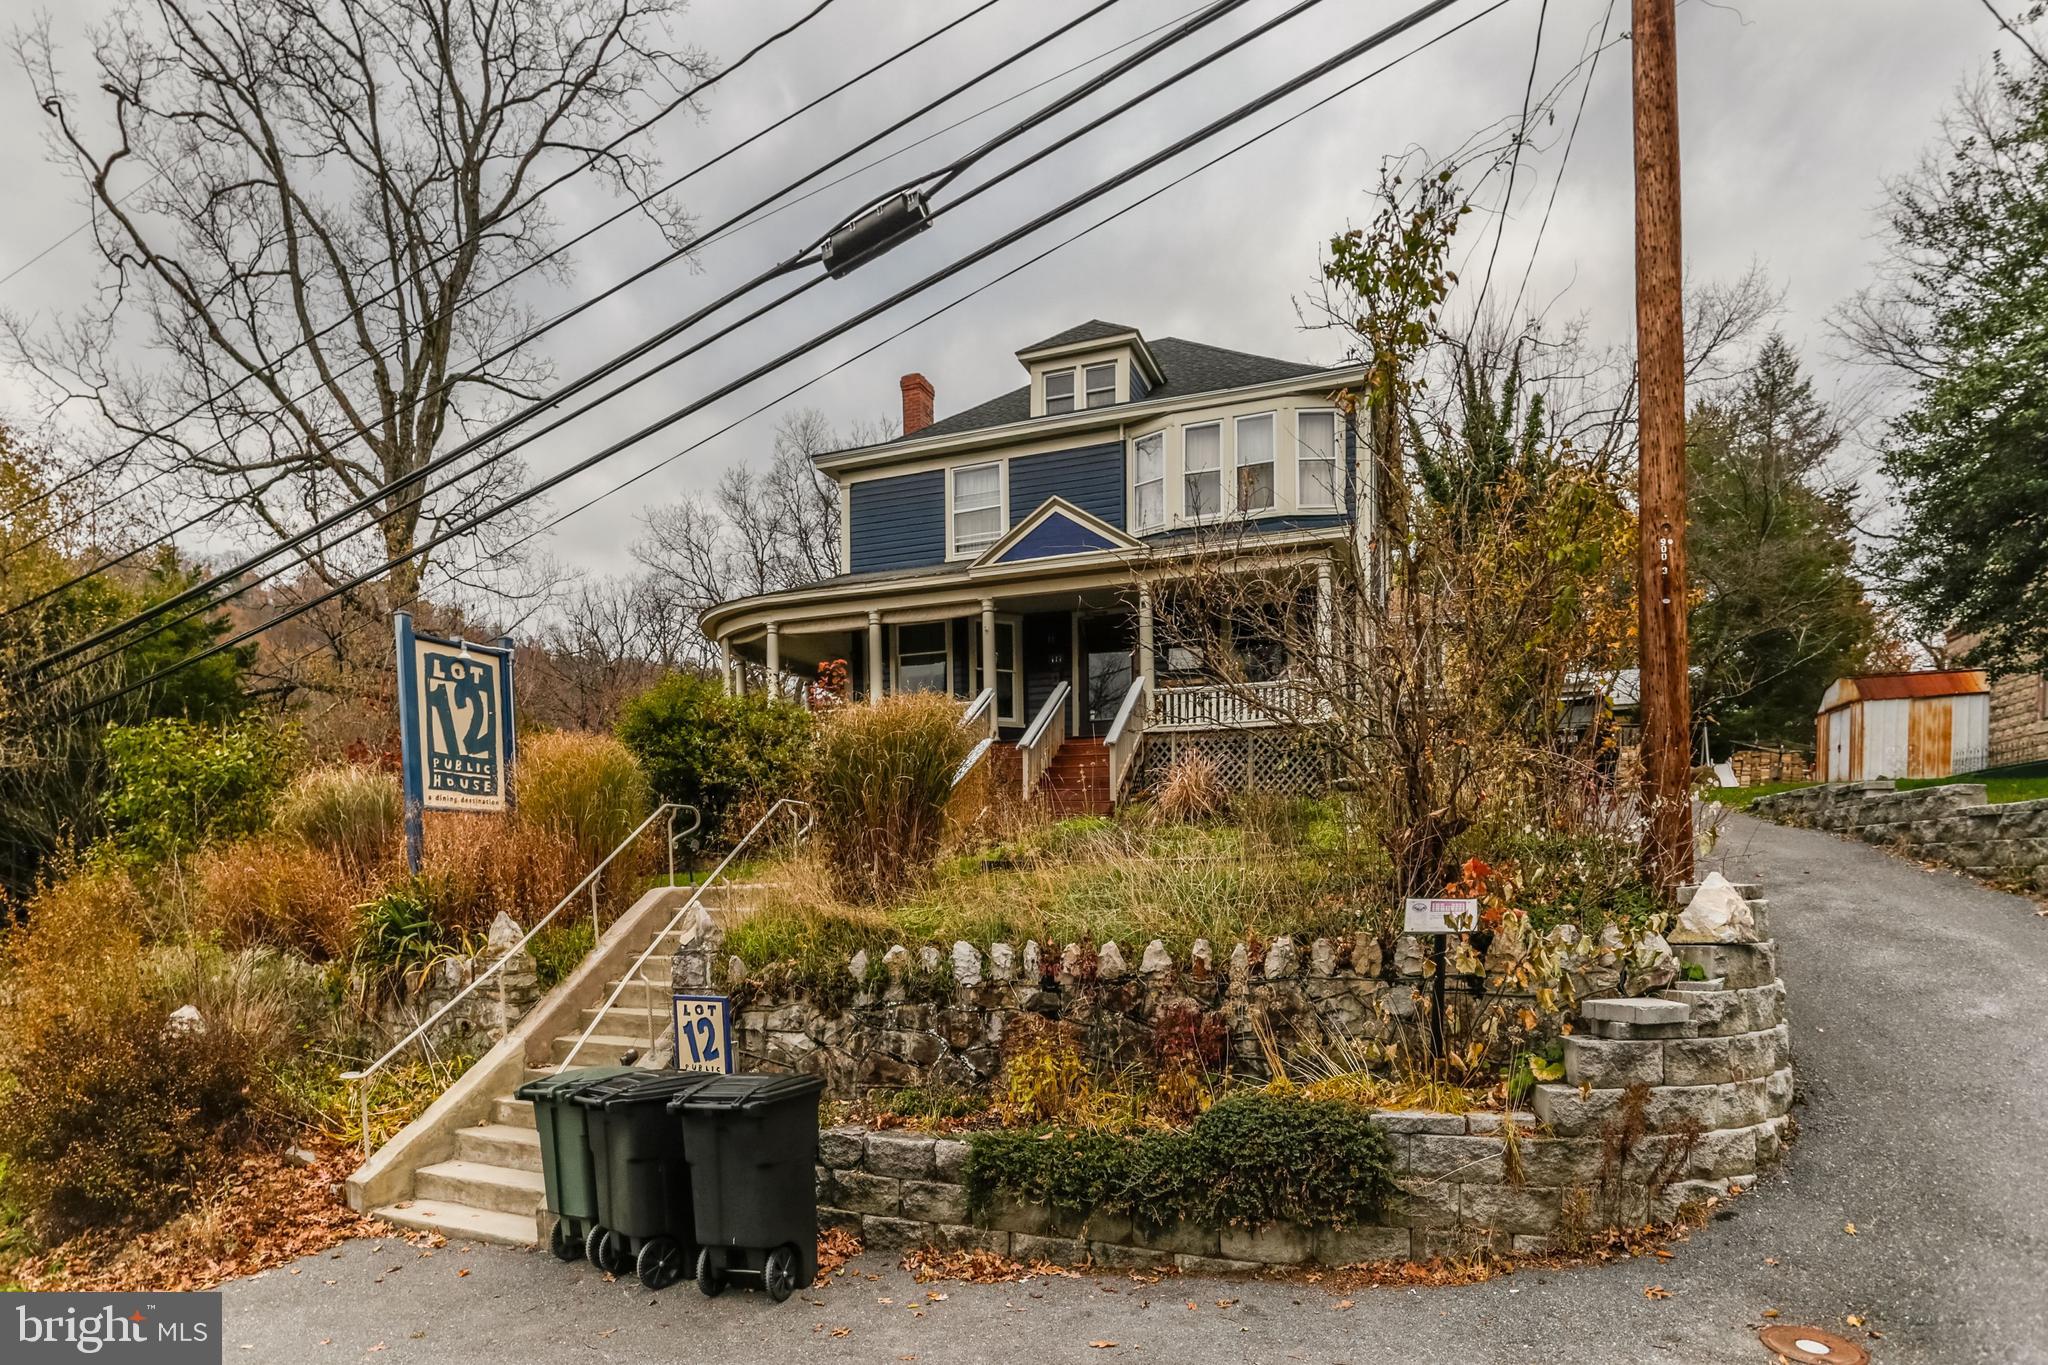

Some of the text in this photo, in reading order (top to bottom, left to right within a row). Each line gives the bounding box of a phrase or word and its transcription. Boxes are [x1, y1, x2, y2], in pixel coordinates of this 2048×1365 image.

[433, 659, 484, 684] LOT
[429, 679, 490, 755] 12
[433, 758, 491, 774] PUBLIC
[433, 775, 492, 793] HOUSE
[435, 795, 458, 804] dining
[461, 797, 500, 806] destination
[683, 1004, 716, 1016] LOT
[683, 1017, 720, 1063] 12
[684, 1063, 720, 1072] PUBLIC
